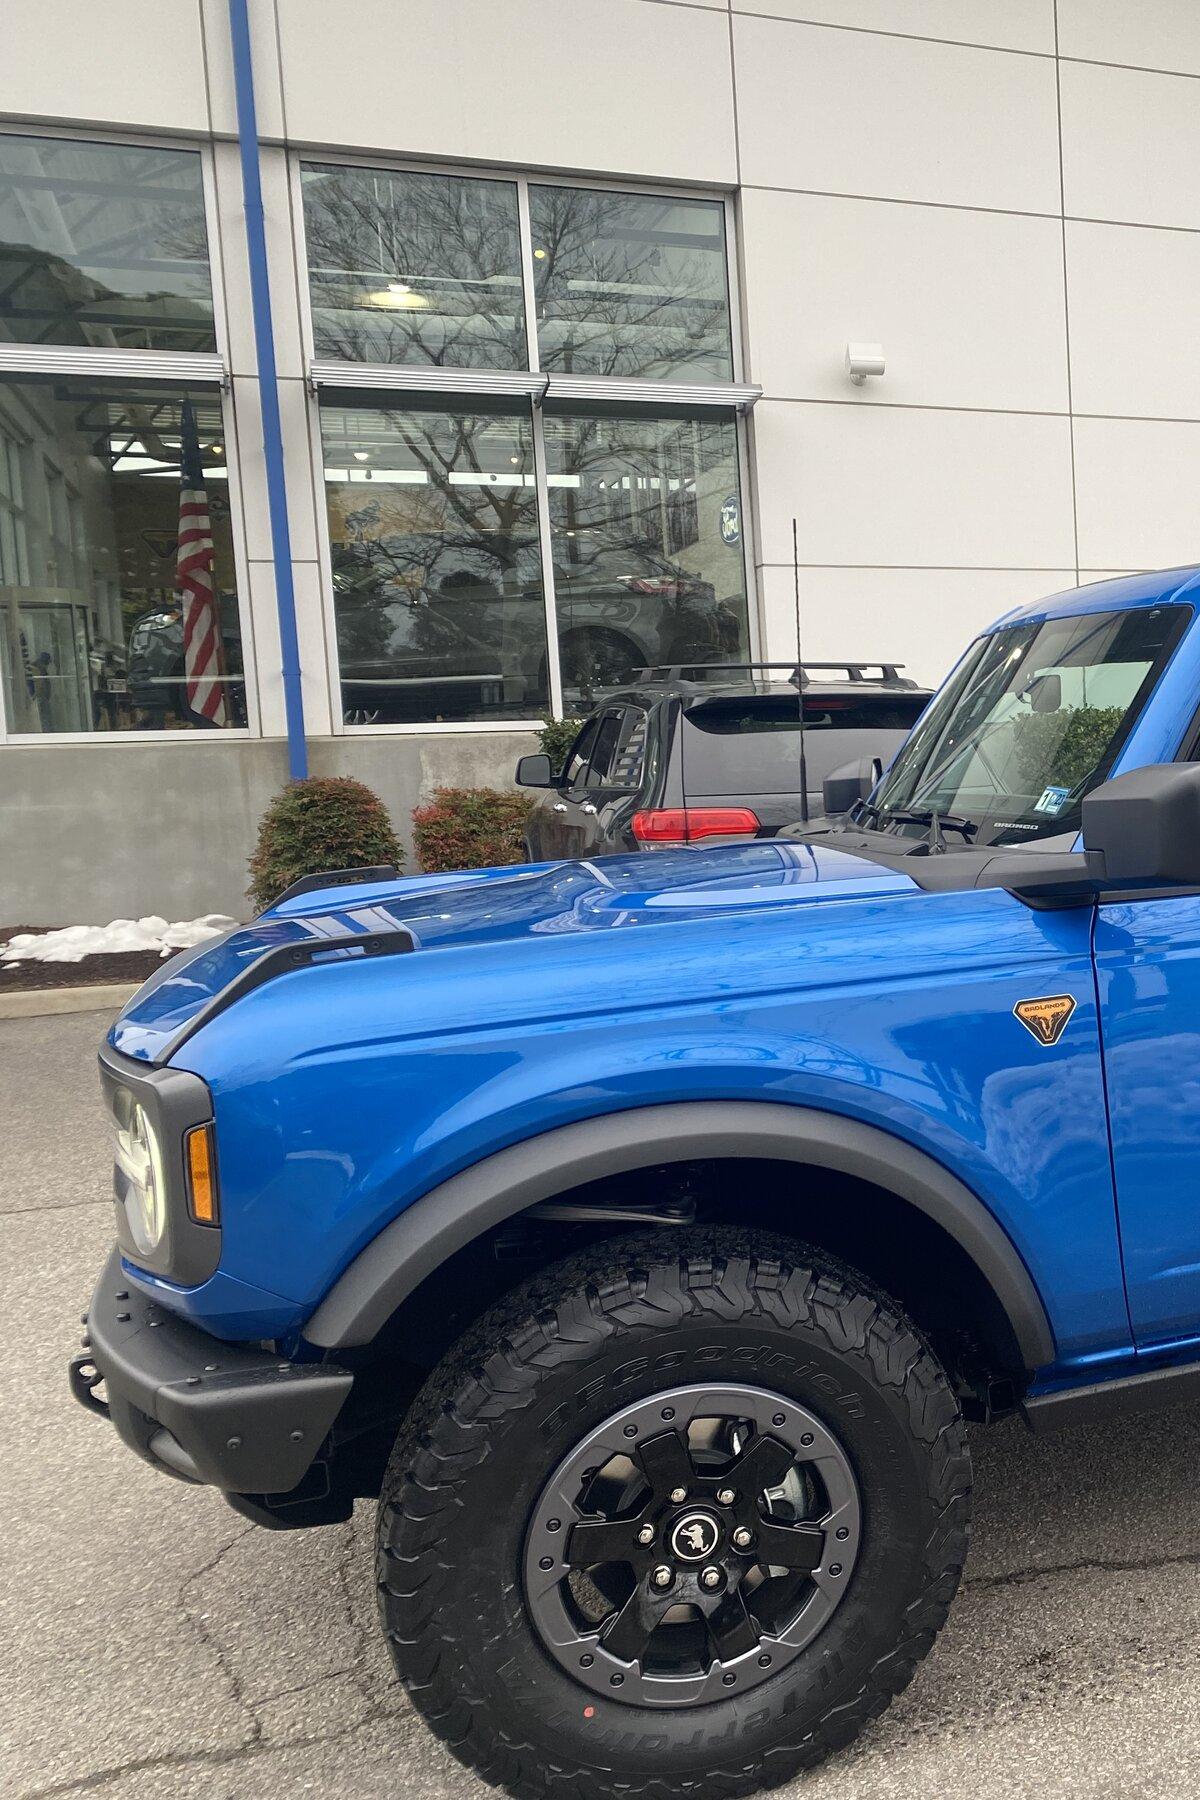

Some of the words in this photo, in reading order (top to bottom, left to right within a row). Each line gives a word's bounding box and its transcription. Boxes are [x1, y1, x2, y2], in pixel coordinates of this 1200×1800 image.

[993, 822, 1039, 830] BRONCO
[1024, 1001, 1066, 1012] BADLANDS
[536, 1344, 868, 1445] BFGoodrich
